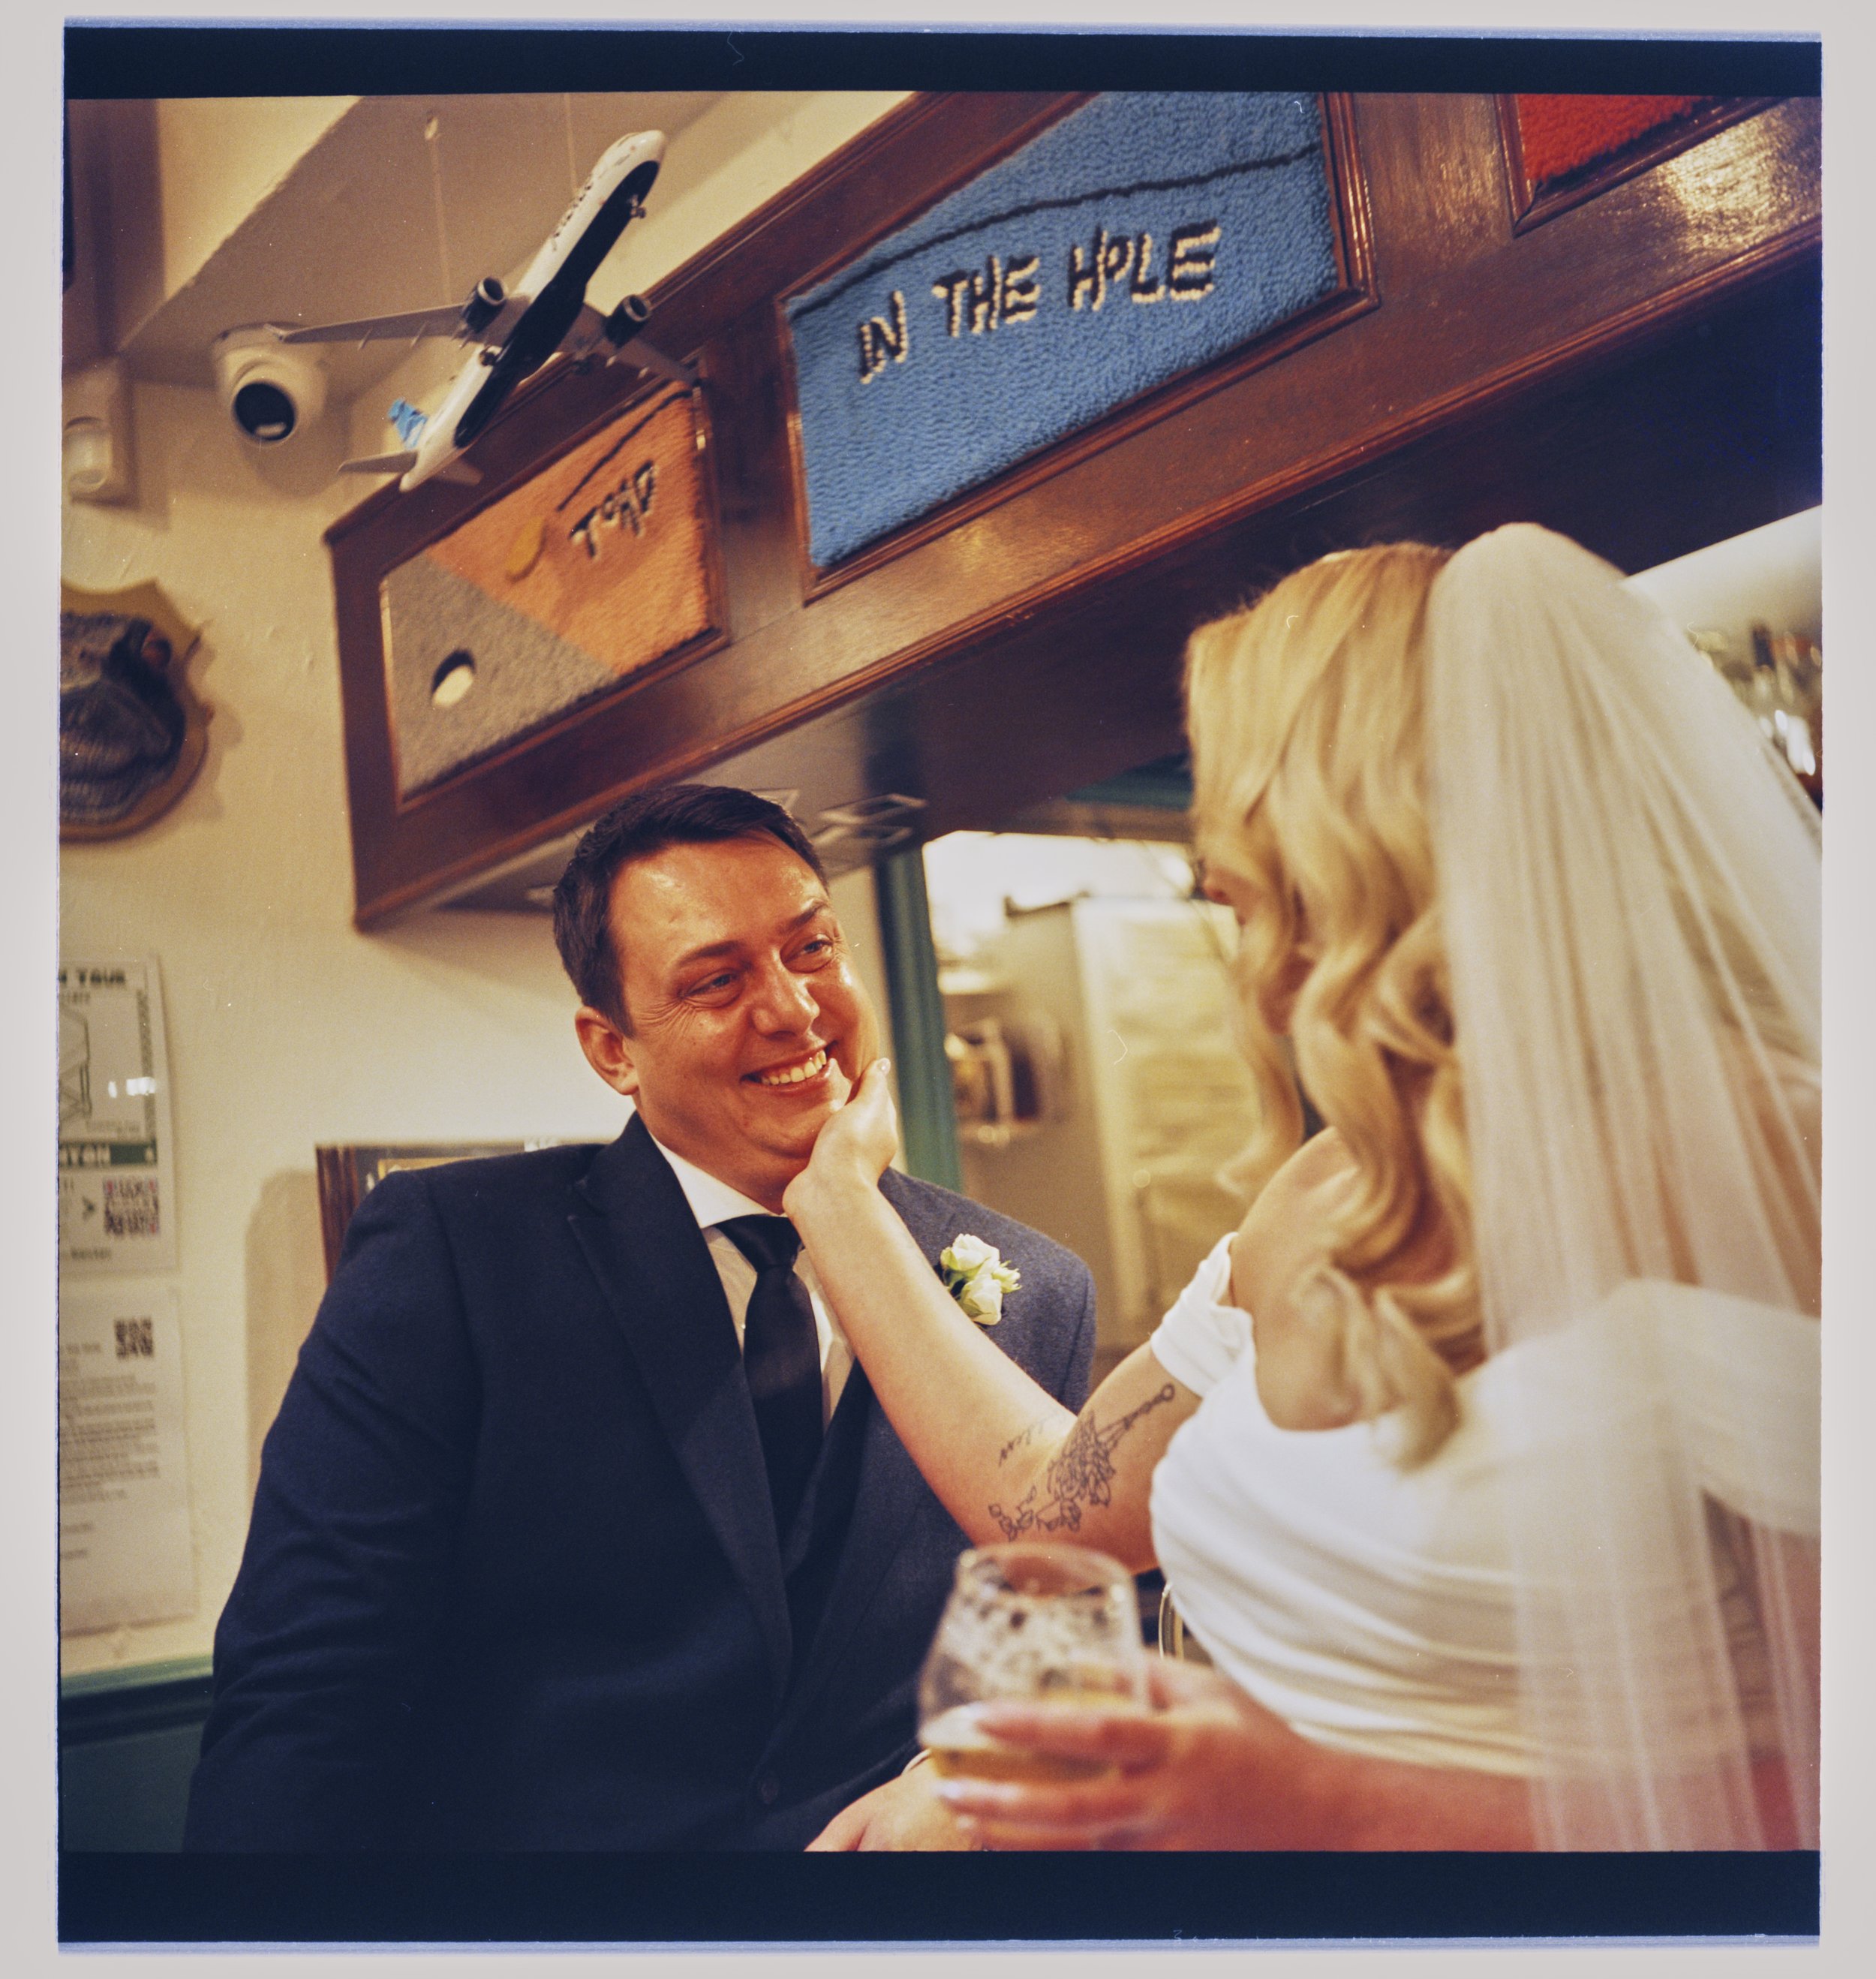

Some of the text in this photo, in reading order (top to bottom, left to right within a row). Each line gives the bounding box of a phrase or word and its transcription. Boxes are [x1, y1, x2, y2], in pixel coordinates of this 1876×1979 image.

[858, 218, 1222, 384] IN THE HOLE
[568, 459, 660, 563] TOAD
